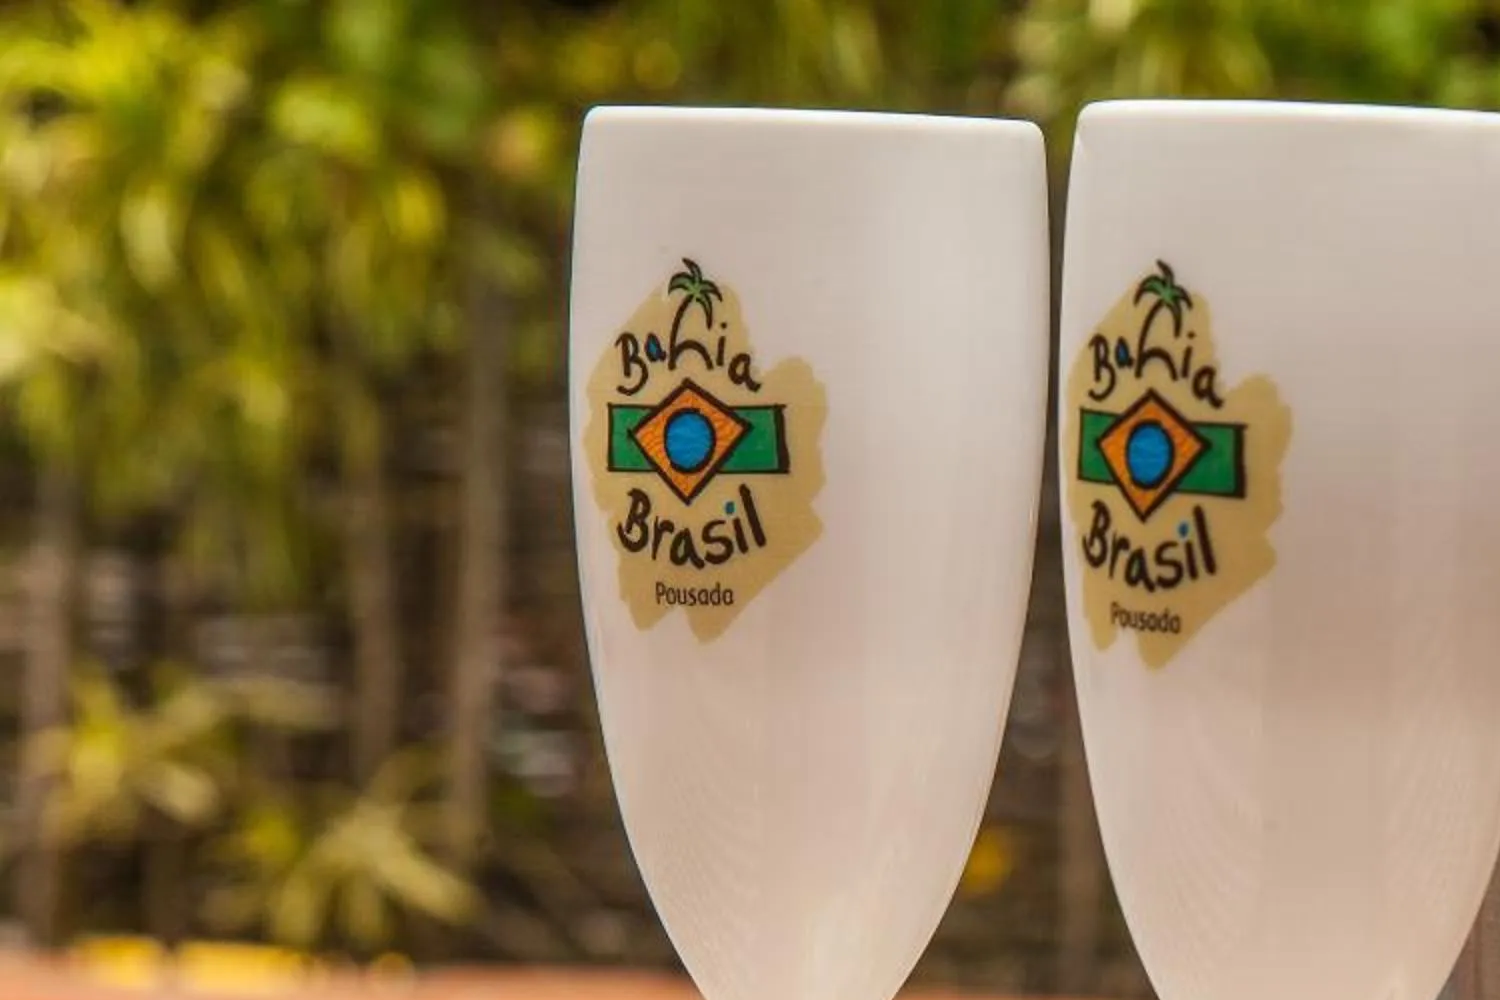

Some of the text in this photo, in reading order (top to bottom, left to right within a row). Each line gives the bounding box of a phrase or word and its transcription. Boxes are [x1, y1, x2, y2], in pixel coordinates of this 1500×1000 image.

[615, 285, 761, 396] Bahia
[1088, 285, 1224, 409] Bahia
[617, 483, 767, 570] Brasil
[1082, 500, 1217, 593] Brasil
[655, 580, 734, 606] Pousada
[1110, 602, 1182, 635] Pousada
